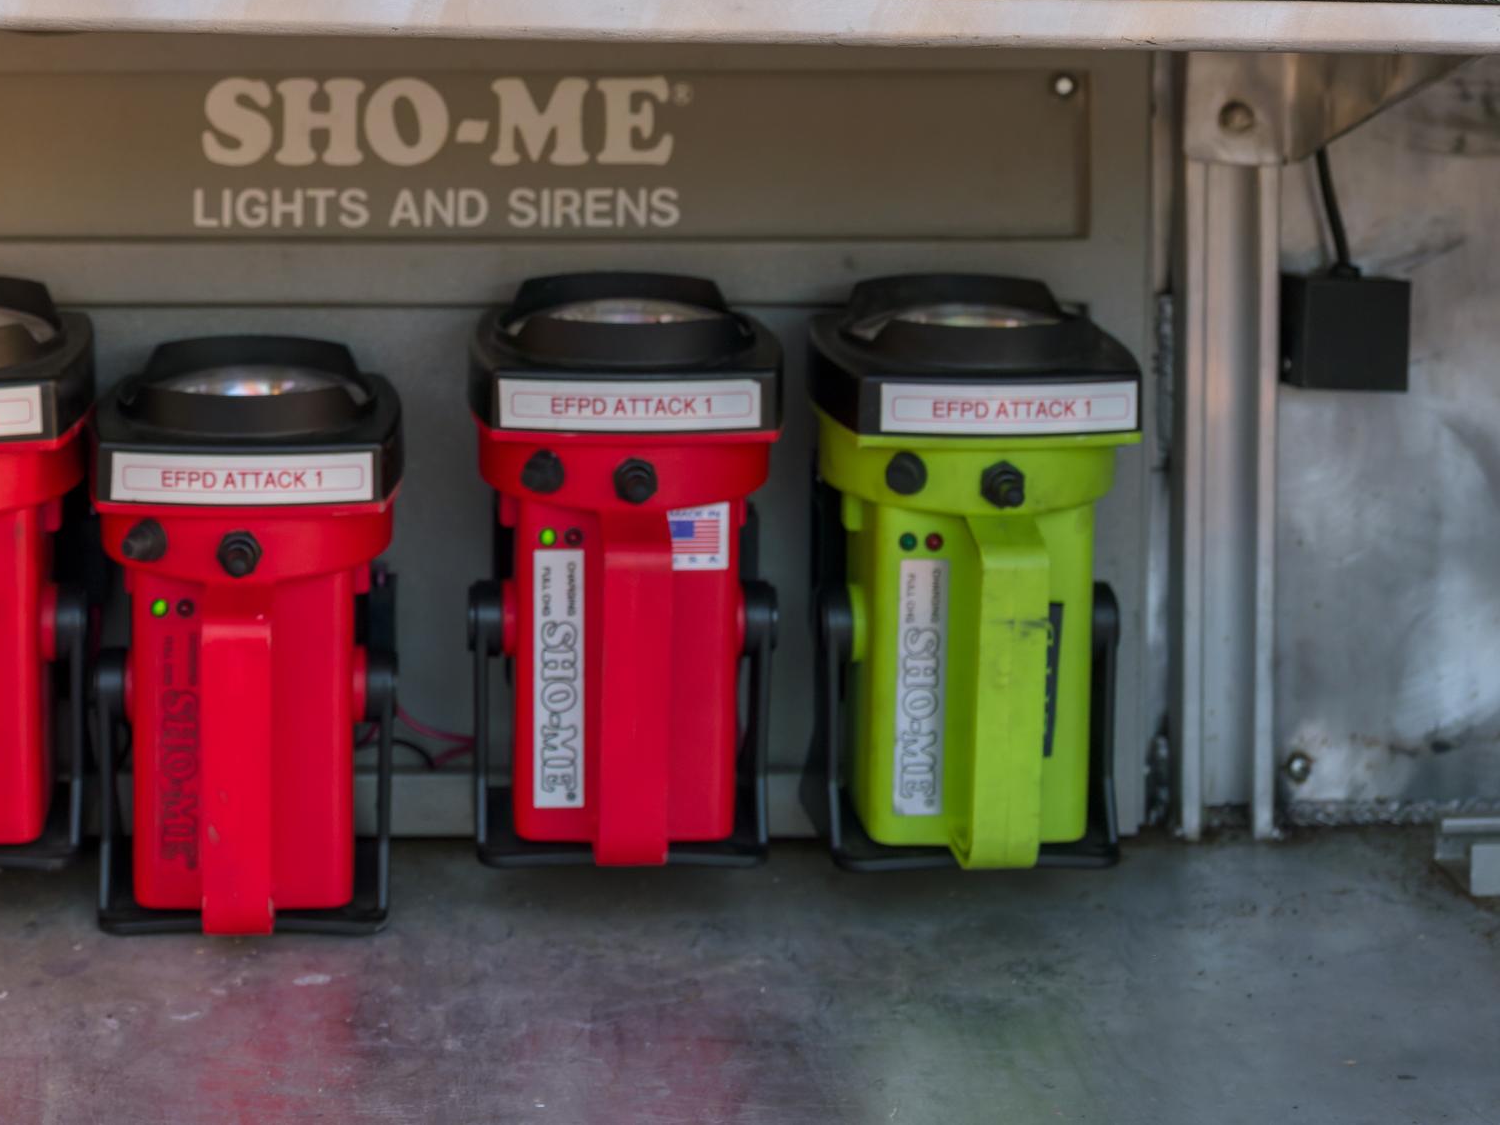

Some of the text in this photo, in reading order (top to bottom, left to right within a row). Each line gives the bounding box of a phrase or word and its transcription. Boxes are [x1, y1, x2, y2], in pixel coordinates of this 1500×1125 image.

[193, 187, 682, 228] LIGHTS AND SIRENS
[551, 396, 713, 416] EFPD ATTACK 1
[932, 399, 1092, 419] EFPD ATTACK 1
[161, 470, 324, 489] EFPD ATTACK 1
[567, 561, 577, 617] CHARGING
